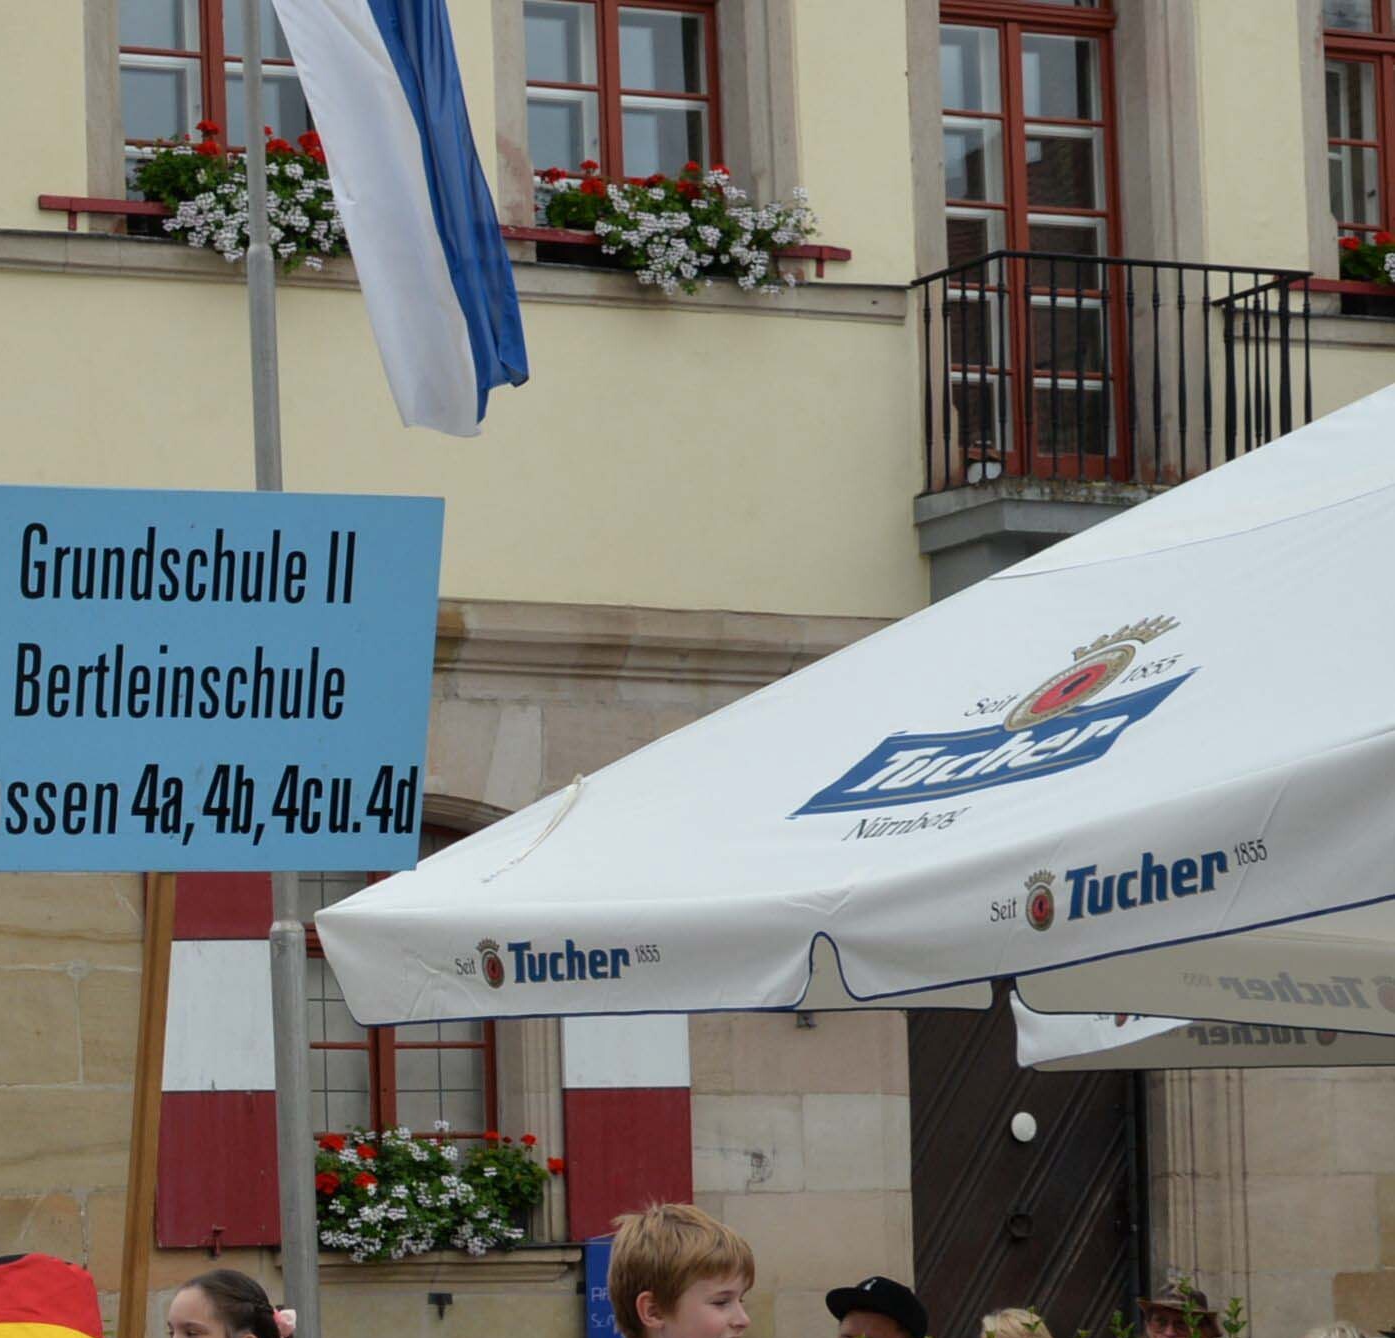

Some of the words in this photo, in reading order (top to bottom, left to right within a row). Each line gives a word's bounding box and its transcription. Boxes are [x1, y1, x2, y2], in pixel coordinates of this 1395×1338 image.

[19, 522, 308, 604] Grundschule
[326, 530, 357, 605] II
[14, 642, 346, 720] Bertleinschule
[964, 694, 1019, 717] Seit
[841, 714, 1130, 794] Tucher
[841, 806, 973, 842] Nürnberg
[990, 900, 1017, 922] Seit
[1064, 851, 1229, 921] Tucher
[1234, 839, 1268, 866] 1855
[455, 957, 477, 976] Seit
[507, 939, 631, 984] Tucher
[635, 944, 662, 964] 1855
